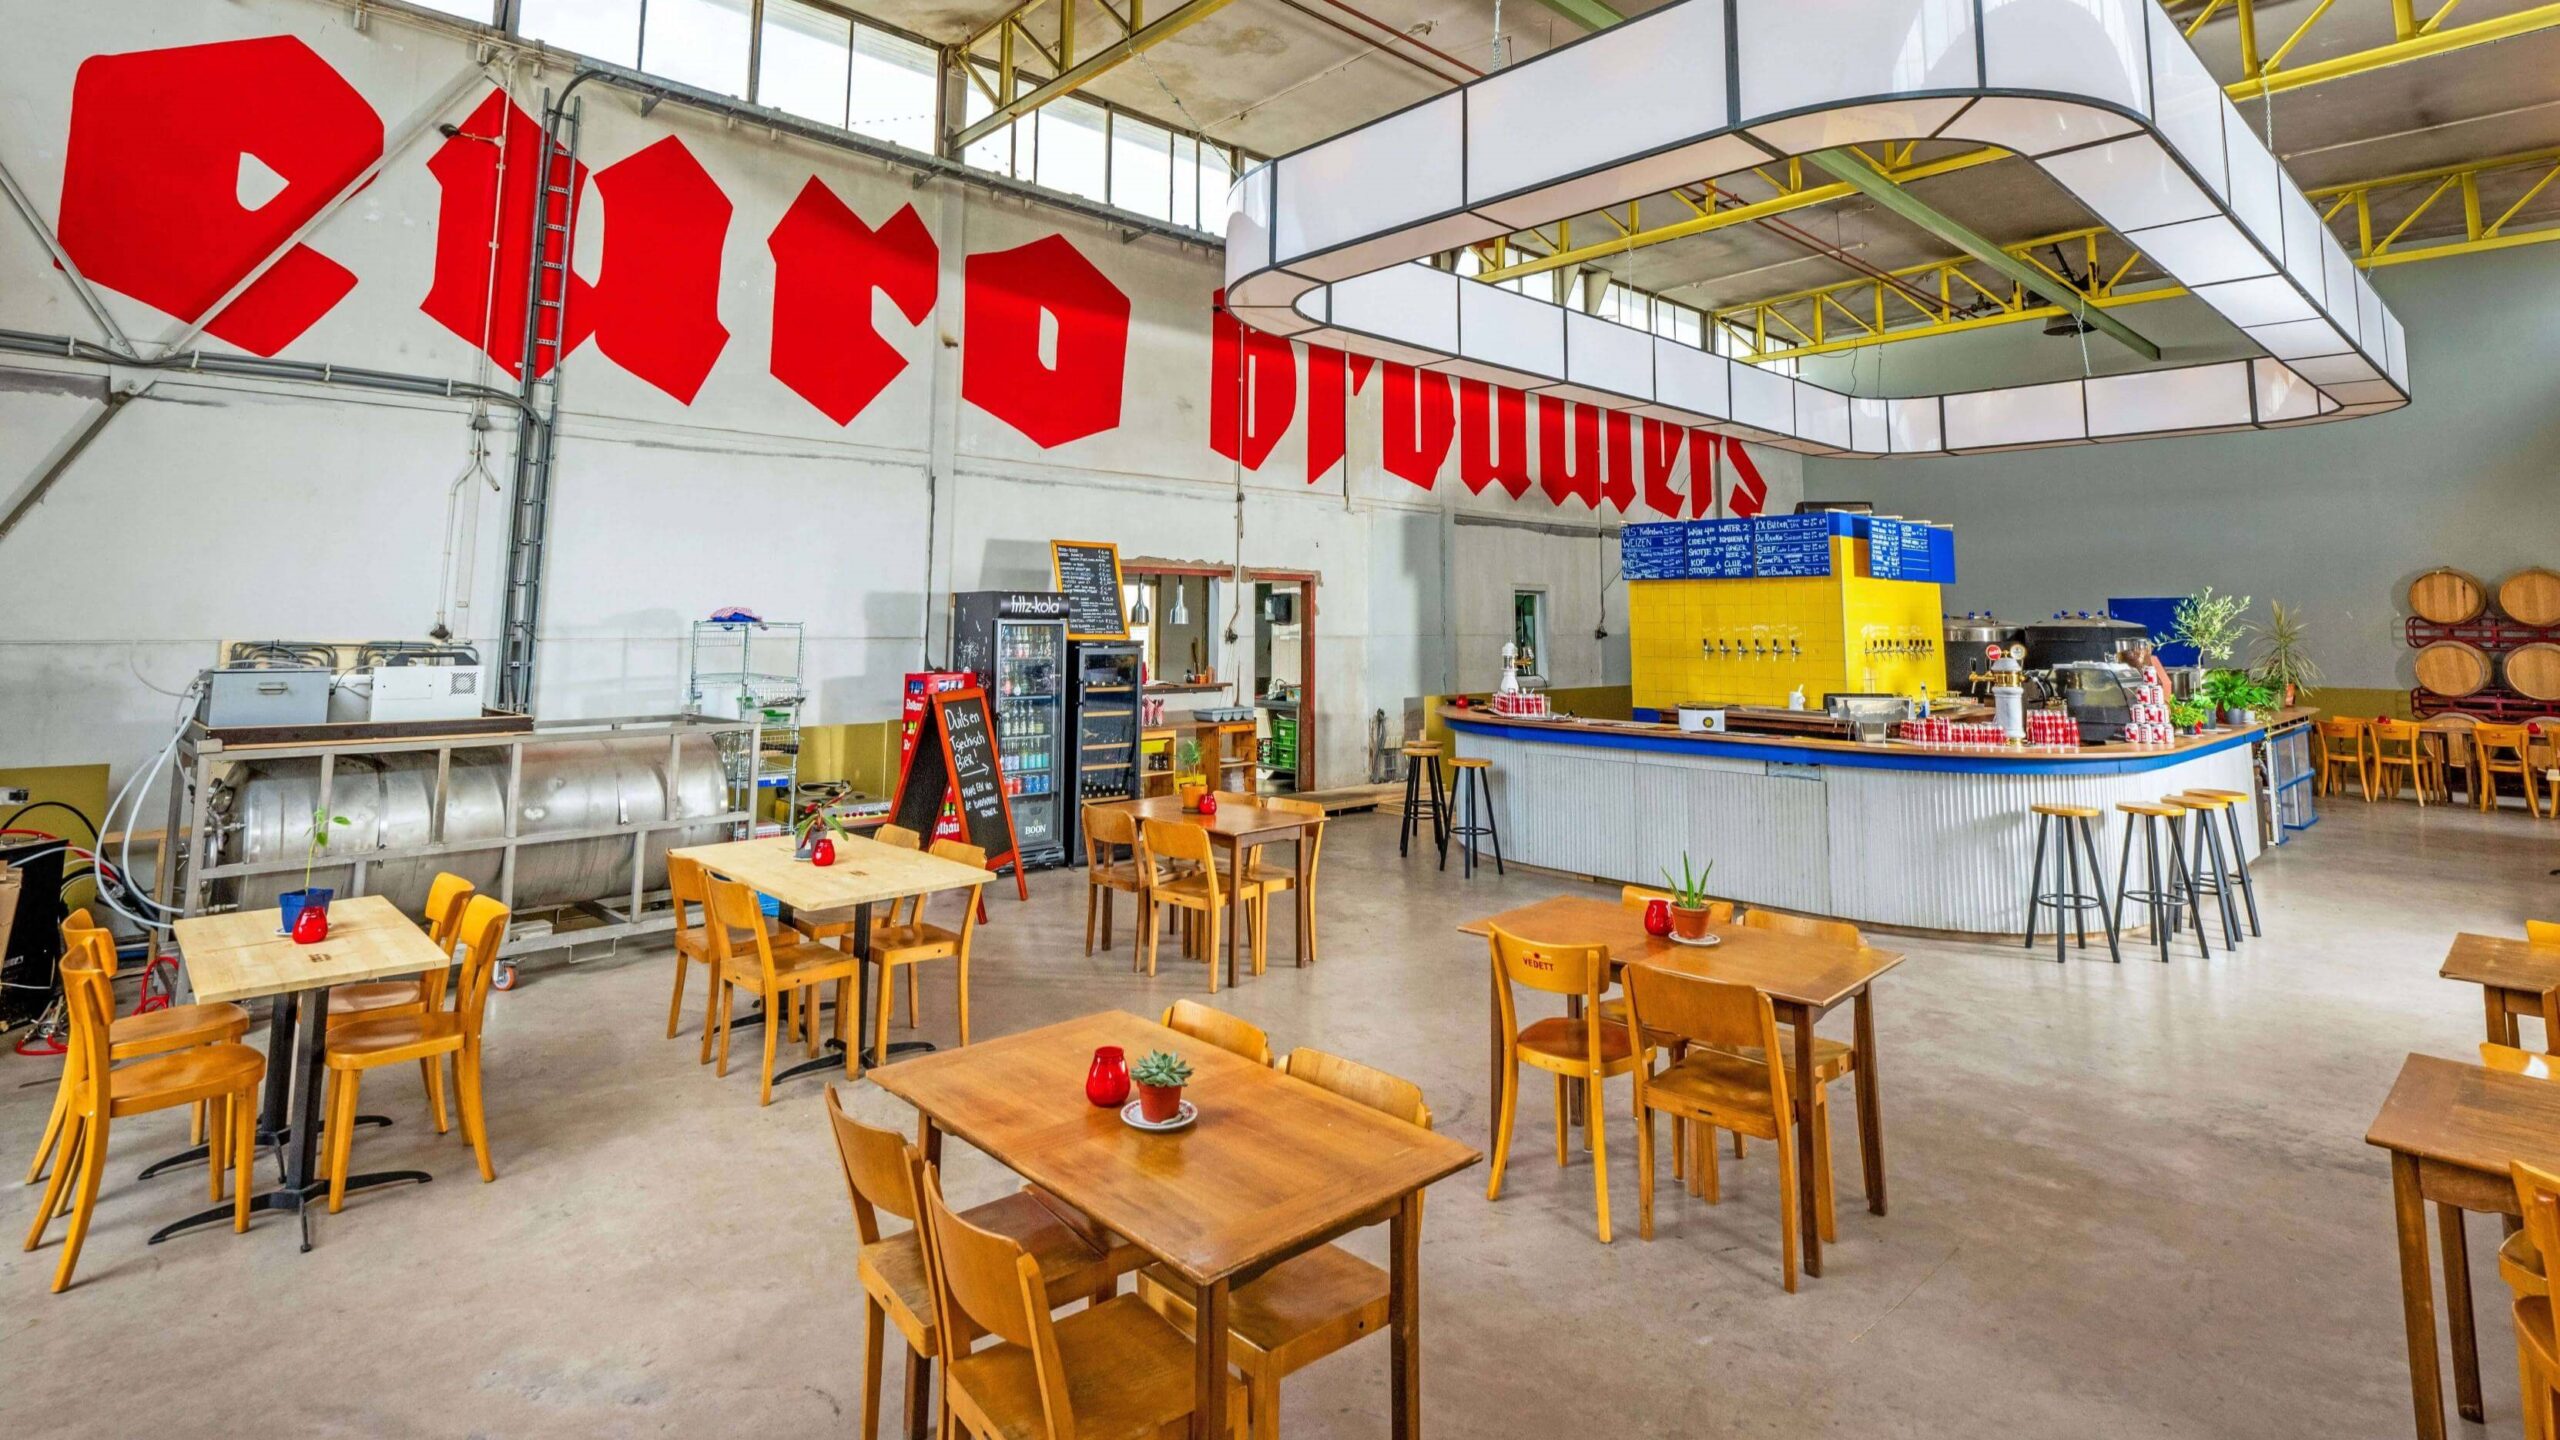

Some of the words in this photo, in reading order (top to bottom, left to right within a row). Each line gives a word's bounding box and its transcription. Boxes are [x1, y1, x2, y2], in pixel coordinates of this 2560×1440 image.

[1621, 527, 1637, 538] PILS
[1718, 523, 1742, 533] WATER
[1622, 537, 1652, 548] WEIZEN
[1687, 538, 1707, 546] CIDER
[1690, 558, 1706, 567] KOP
[1724, 559, 1742, 568] CLUB
[1688, 566, 1717, 577] STOOTJE
[1715, 560, 1722, 570] 6
[1724, 567, 1742, 576] MATE
[1011, 594, 1061, 614] fritz-kola
[944, 706, 970, 731] Duits
[969, 712, 980, 724] en
[1025, 823, 1047, 835] BOON
[1522, 957, 1554, 971] VEDETT
